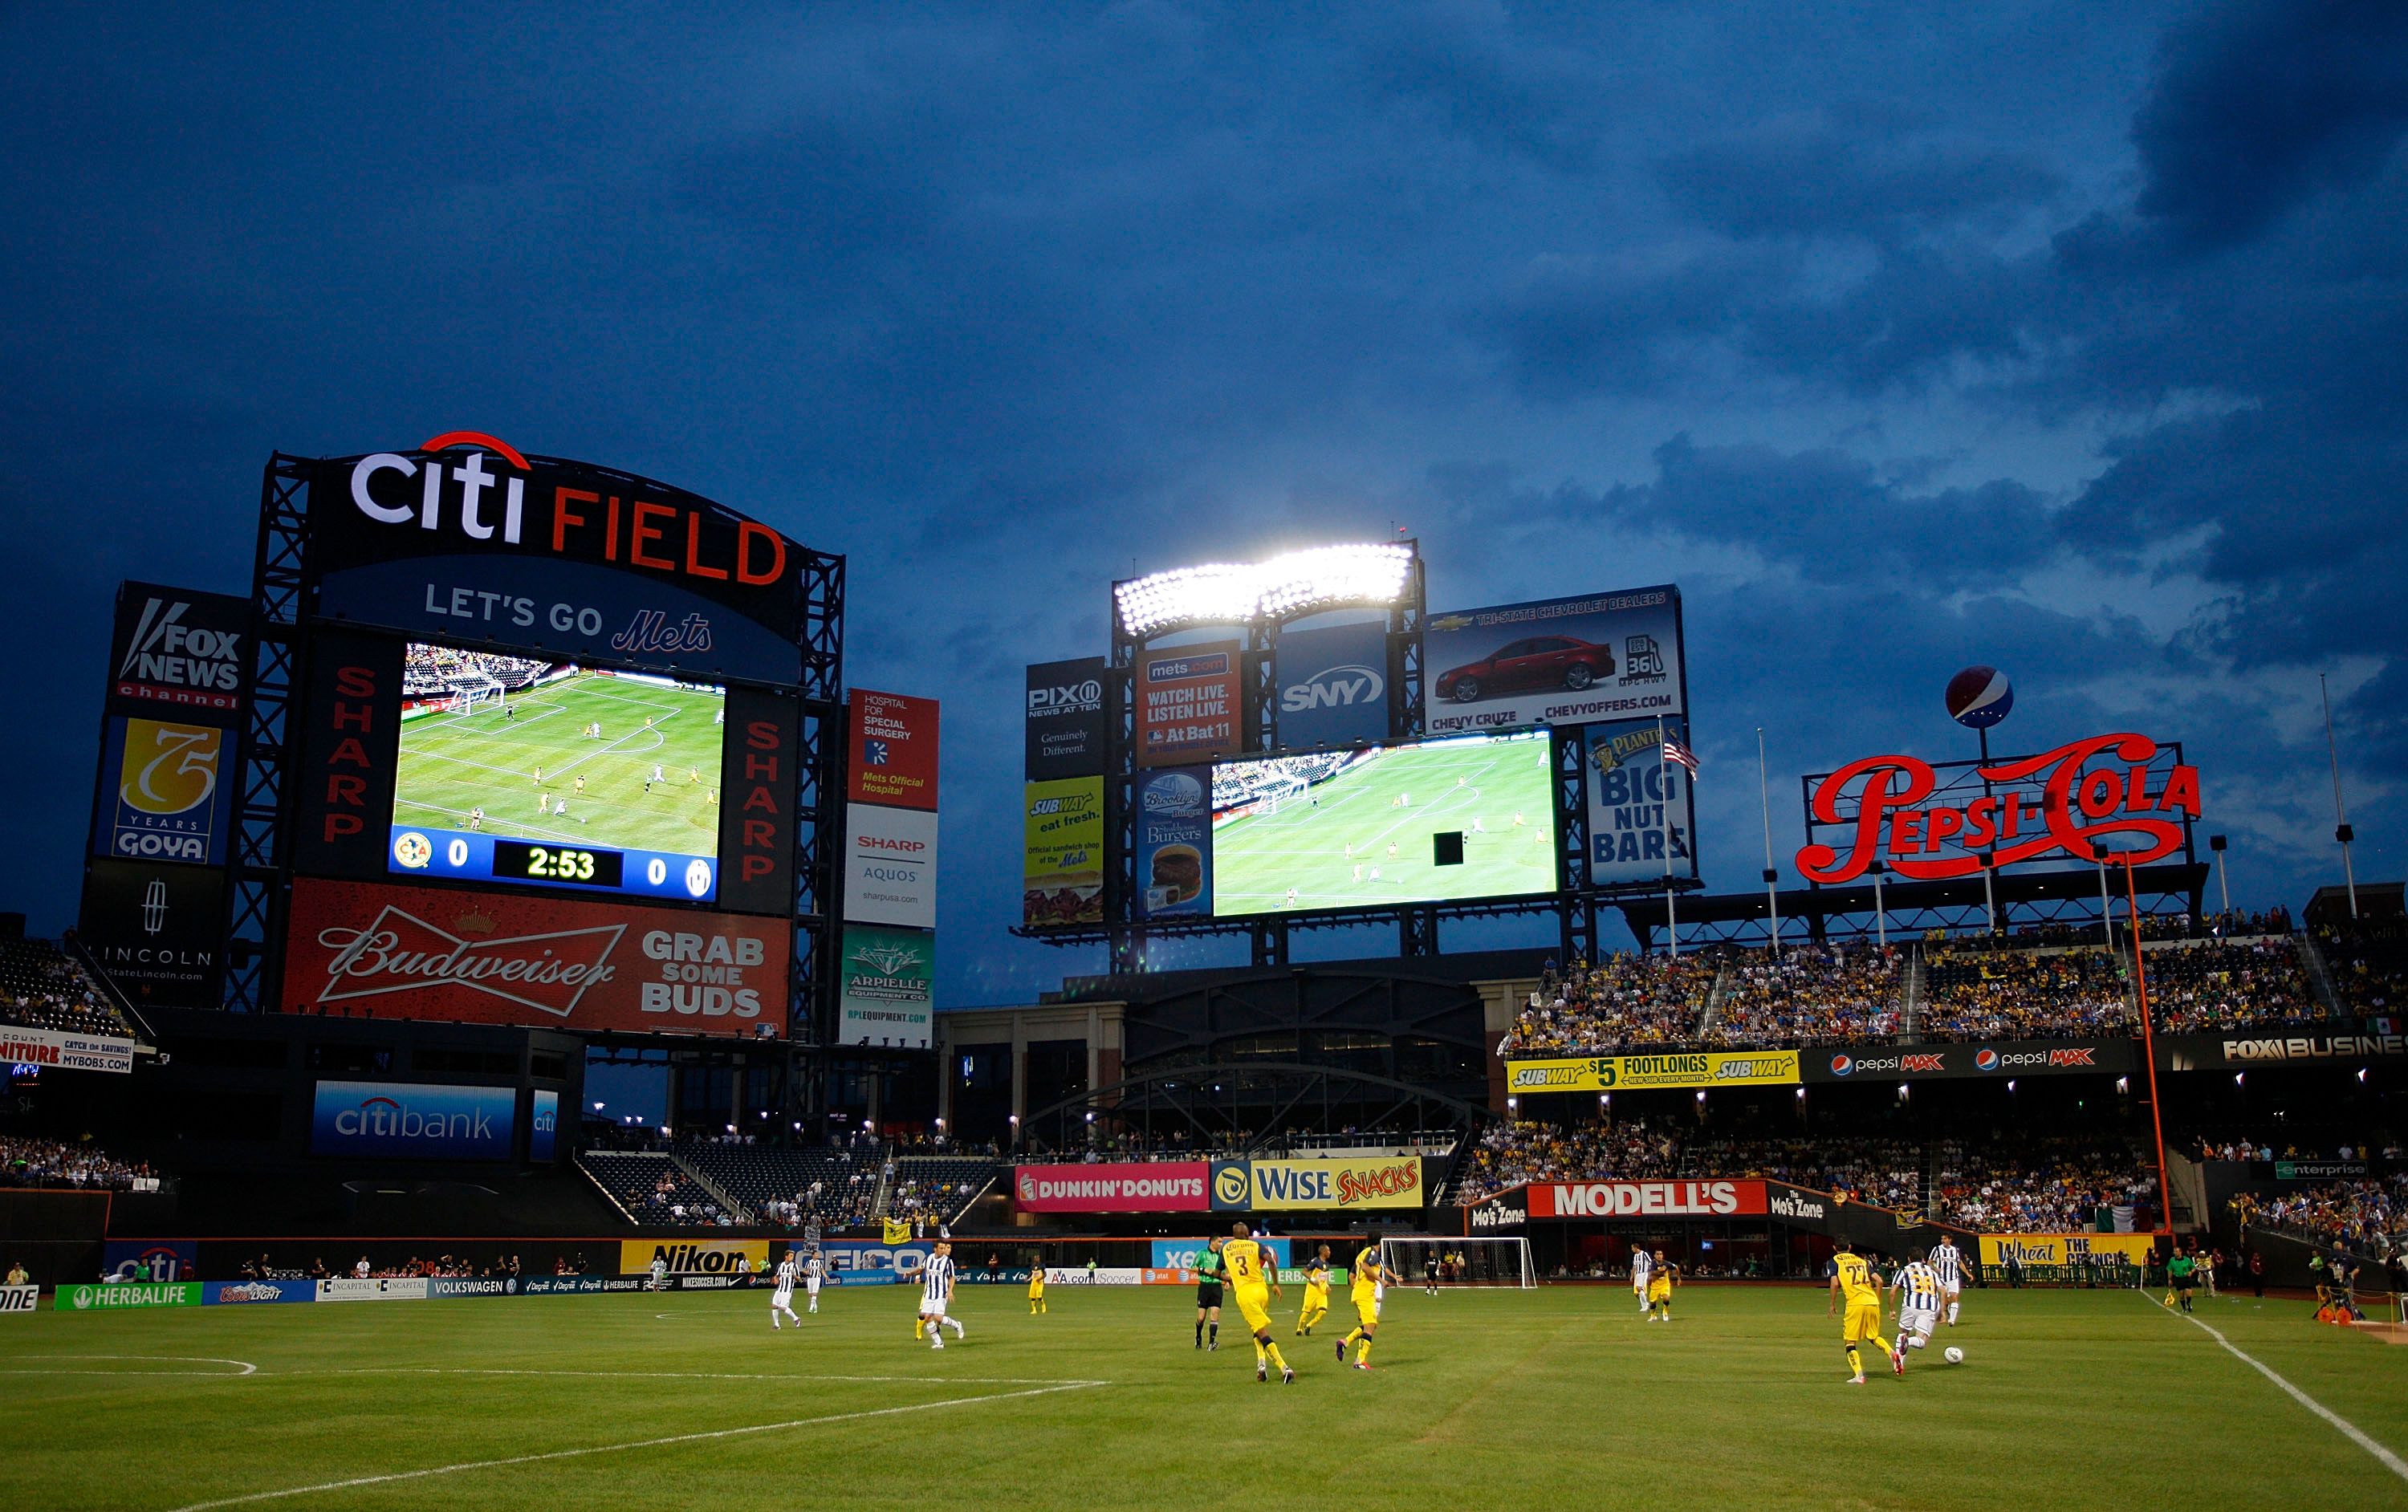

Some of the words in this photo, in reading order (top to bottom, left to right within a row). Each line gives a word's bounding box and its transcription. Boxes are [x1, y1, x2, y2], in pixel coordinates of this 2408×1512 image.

[351, 452, 526, 545] citi
[552, 486, 787, 586] FIELD
[425, 583, 535, 627] LET'S
[550, 604, 603, 636] GO
[612, 610, 712, 652] Mets
[1477, 611, 1536, 626] TRI-STATE
[1536, 600, 1607, 618] CHEVROLET
[1609, 591, 1666, 611] DEALERS
[165, 624, 241, 662] FOX
[138, 652, 239, 690] NEWS
[1628, 657, 1650, 674] 36
[1619, 679, 1639, 688] MPG
[1643, 676, 1667, 685] HWY
[120, 685, 238, 709] channel
[864, 694, 907, 709] HOSPITAL
[1148, 688, 1194, 706] WATCH
[1198, 684, 1229, 701] LIVE.
[1281, 678, 1363, 712] SNY
[864, 705, 883, 716] FOR
[1029, 709, 1060, 718] NEWS
[1063, 706, 1076, 714] AT
[1079, 703, 1101, 712] TEN
[1148, 704, 1194, 723] LISTEN
[1197, 701, 1229, 717] LIVE.
[1545, 694, 1671, 718] CHEVYOFFERS.COM
[864, 716, 905, 730] SPECIAL
[1432, 715, 1473, 730] CHEVY
[1475, 711, 1516, 725] CRUZE
[864, 726, 911, 740] SURGERY
[1041, 729, 1088, 743] Genuinely
[1166, 727, 1185, 742] At
[1186, 725, 1214, 740] Bat
[1216, 722, 1230, 737] 11
[323, 665, 377, 843] SHARP
[1043, 744, 1085, 757] Different.
[862, 783, 903, 795] Hospital
[863, 772, 887, 782] Mets
[889, 775, 924, 787] Official
[1600, 763, 1676, 807] BIG
[742, 721, 781, 882] SHARP
[1030, 793, 1093, 817] SUBWAY
[1146, 791, 1198, 808] Brooklyn
[130, 815, 197, 831] YEARS
[1040, 819, 1060, 833] eat
[1064, 811, 1100, 826] fresh.
[1173, 809, 1203, 819] Burger
[1614, 804, 1664, 830] NUT
[858, 836, 925, 852] SHARP
[1147, 827, 1202, 843] Burgers
[118, 832, 205, 860] GOYA
[449, 839, 468, 867] 0
[1028, 845, 1051, 855] Official
[1053, 843, 1083, 852] sandwich
[1084, 842, 1100, 851] shop
[527, 847, 595, 880] 2:53
[1059, 851, 1088, 868] Mets
[648, 859, 667, 885] 0
[864, 867, 916, 882] AQUOS
[863, 892, 918, 904] sharpusa.com
[88, 945, 210, 965] INCOLN
[318, 927, 616, 986] Budweiser
[643, 930, 765, 966] GRAB
[662, 963, 742, 986] SOME
[851, 976, 927, 990] ARPIELLE
[642, 983, 761, 1018] BUDS
[848, 990, 906, 1000] EQUIPMENT
[909, 993, 928, 1002] CO.
[848, 1010, 926, 1023] RPLEQUIPMENT.COM
[65, 1040, 87, 1051] CATCH
[101, 1045, 132, 1055] SAVINGS!
[2002, 1051, 2047, 1067] pepsi
[2048, 1047, 2096, 1067] MAX
[2223, 1038, 2273, 1060] FOX
[63, 1055, 129, 1071] MYBOBS.COM
[1512, 1064, 1588, 1088] SUBWAY
[1624, 1055, 1708, 1075] FOOTLONGS
[1716, 1056, 1796, 1080] SUBWAY
[1856, 1056, 1898, 1072] pepsi
[1900, 1053, 1946, 1071] MAX
[1644, 1076, 1658, 1084] SUB
[1659, 1075, 1678, 1083] EVERY
[1681, 1075, 1705, 1083] MONTH
[335, 1104, 493, 1140] citibank
[535, 1115, 555, 1132] citi
[2282, 1162, 2365, 1176] enterprise
[1039, 1180, 1121, 1199] DUNKIN'
[1123, 1177, 1203, 1197] DONUTS
[1256, 1168, 1332, 1201] WISE
[1336, 1160, 1420, 1206] SNACKS
[1491, 1199, 1501, 1207] The
[1554, 1181, 1738, 1216] MODELL'S
[1788, 1189, 1799, 1199] The
[1472, 1209, 1495, 1226] Mo's
[1497, 1205, 1525, 1225] Zone
[1771, 1197, 1794, 1216] Mo's
[1796, 1200, 1823, 1219] Zone
[1226, 1242, 1255, 1251] Corona
[1995, 1238, 2056, 1263] Wheat
[2064, 1238, 2089, 1252] THE
[652, 1245, 746, 1272] Nikon
[795, 1249, 929, 1274] GEICO
[1235, 1255, 1248, 1276] 3
[333, 1282, 372, 1291] INCAPITAL
[389, 1280, 426, 1290] INCAPITAL
[435, 1280, 502, 1295] VOLKSWAGEN
[531, 1282, 550, 1291] Degree
[559, 1282, 576, 1291] Degree
[585, 1281, 601, 1290] Degree
[609, 1279, 639, 1290] HERBALIFE
[682, 1276, 726, 1288] NIKESOCCER.COM
[96, 1286, 187, 1306] HERBALIFE
[219, 1286, 250, 1303] Coors
[250, 1290, 283, 1301] LIGHT
